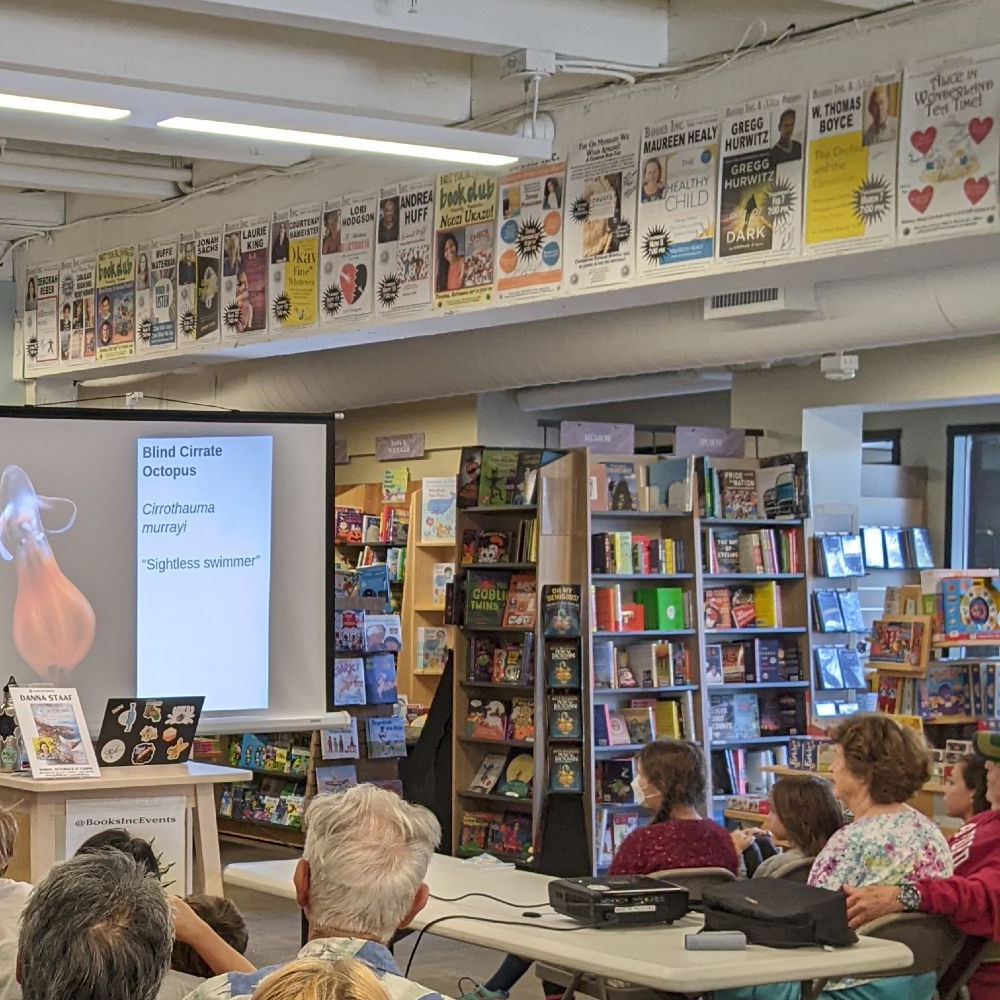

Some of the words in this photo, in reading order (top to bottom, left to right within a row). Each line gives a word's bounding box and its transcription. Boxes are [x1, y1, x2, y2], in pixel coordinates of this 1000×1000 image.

[812, 105, 822, 119] W.
[824, 96, 861, 118] THOMAS
[731, 117, 763, 136] GREGG
[819, 113, 854, 133] BOYCE
[643, 135, 685, 154] MAUREEN
[687, 125, 717, 144] HEALY
[725, 130, 768, 152] HURWITZ
[682, 158, 695, 168] THE
[731, 158, 770, 175] GREGG
[667, 176, 710, 194] HEALTHY
[724, 171, 775, 190] HURWITZ
[401, 189, 433, 209] ANDREA
[440, 181, 467, 210] book
[467, 178, 495, 203] club
[665, 189, 709, 213] CHILD
[350, 204, 367, 216] LORI
[405, 207, 428, 225] HUFF
[342, 212, 375, 227] HODGSON
[242, 225, 267, 239] LAURIE
[726, 225, 766, 244] DARK
[197, 236, 219, 248] JONAH
[198, 243, 219, 255] SACHS
[247, 238, 264, 250] KING
[40, 285, 55, 295] REBER
[142, 445, 176, 459] Blind
[179, 444, 223, 458] Cirrate
[142, 464, 197, 479] Octopus
[733, 479, 755, 487] NATION
[142, 501, 216, 516] Cirrothauma
[142, 520, 187, 536] murrayi
[142, 556, 200, 574] “Sightless
[203, 554, 261, 569] swimmer”
[472, 588, 506, 601] GOBLI
[470, 600, 499, 611] TWINS
[20, 694, 47, 702] DANNA
[48, 694, 73, 702] STAAF
[75, 815, 177, 827] @BooksIncEvents
